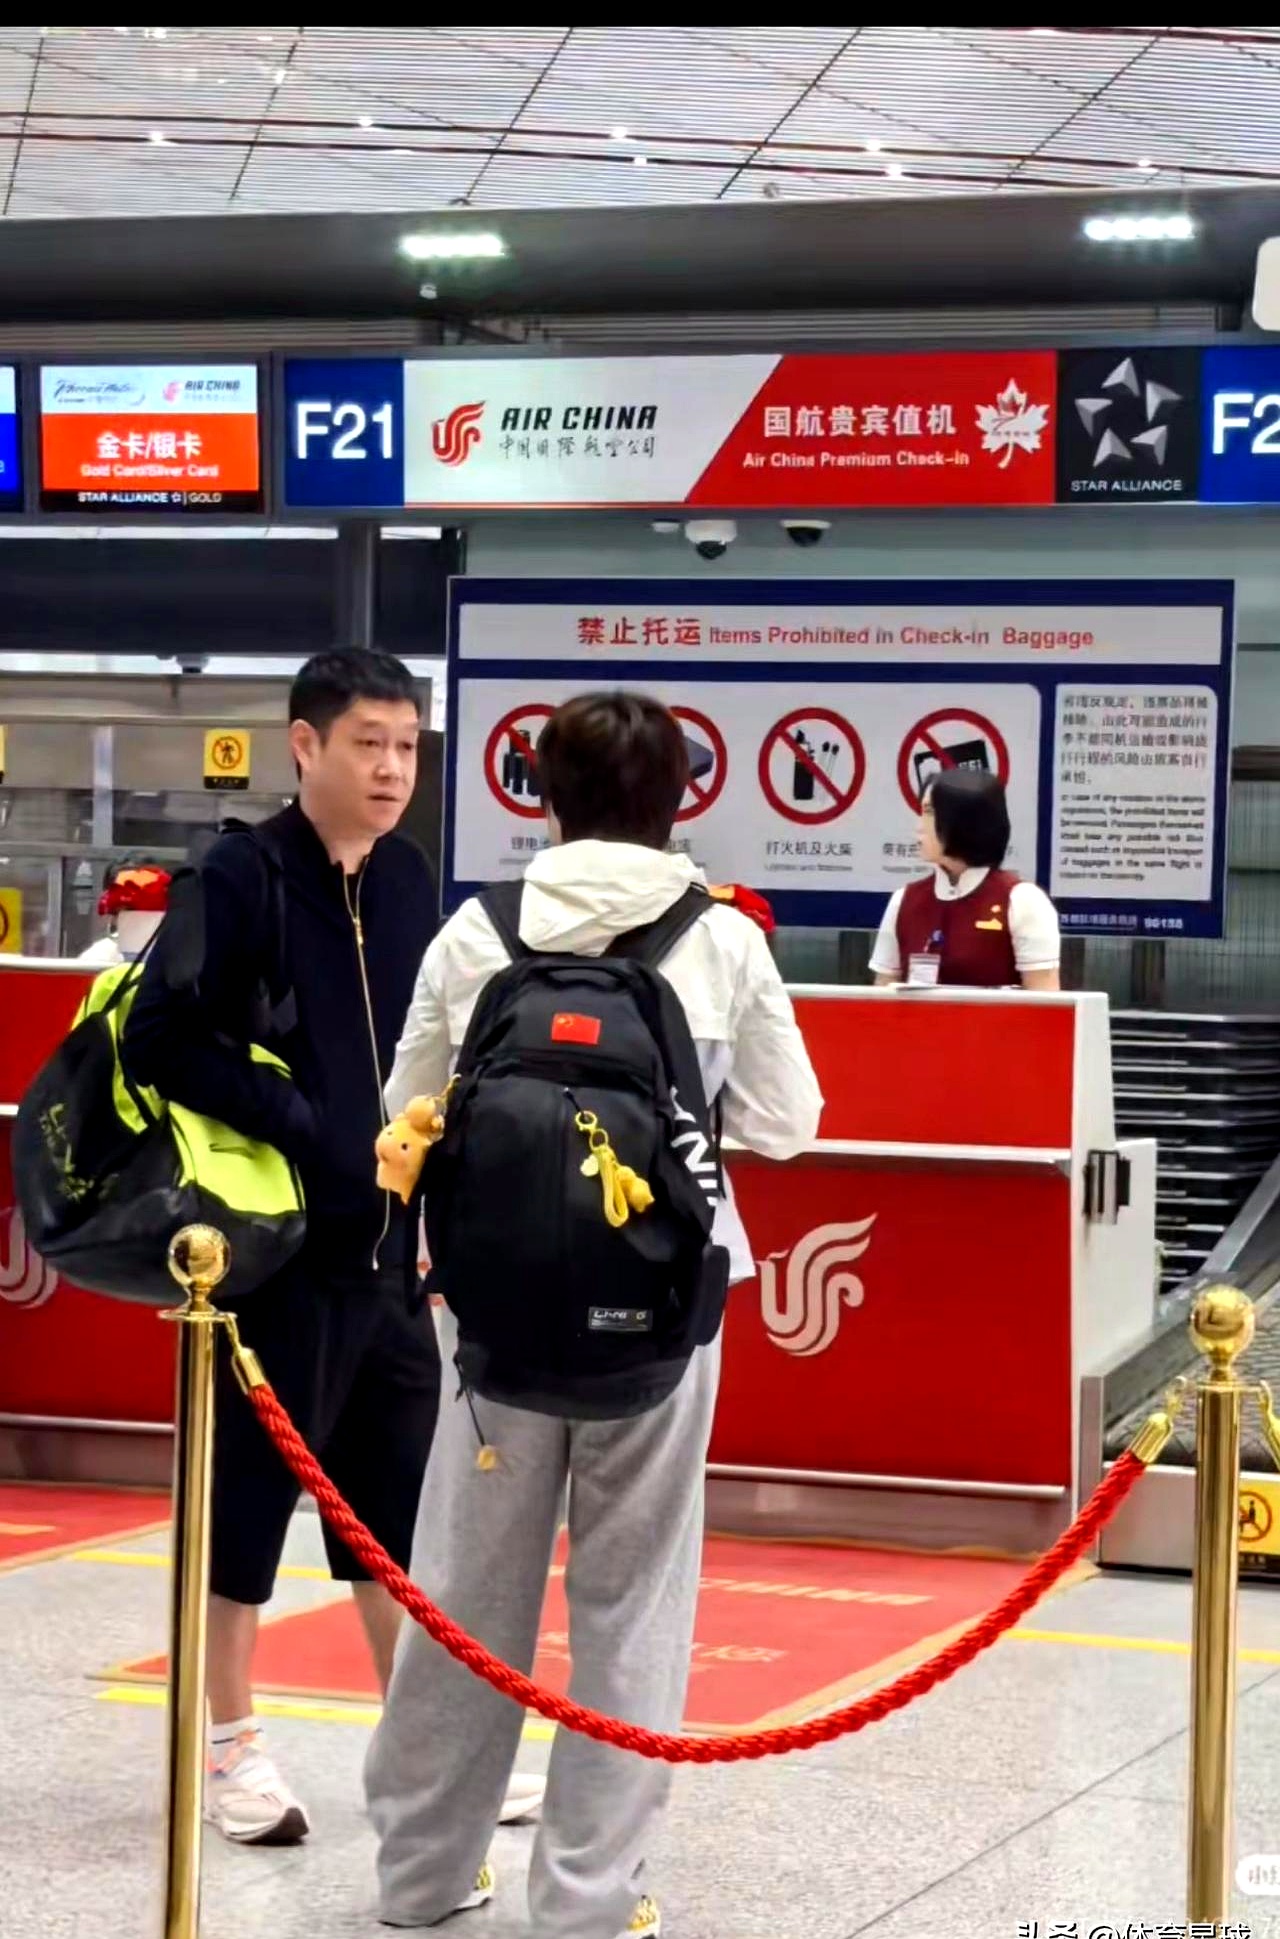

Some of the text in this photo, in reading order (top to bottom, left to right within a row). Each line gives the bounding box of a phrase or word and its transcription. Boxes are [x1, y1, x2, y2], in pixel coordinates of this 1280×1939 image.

[296, 402, 393, 460] F21
[501, 405, 658, 431] AIR CHINA
[763, 404, 957, 438] 国航贵宾值机
[1212, 392, 1280, 455] F2
[96, 431, 203, 460] 金卡/银卡
[743, 450, 970, 468] Air China Premium Check-in
[77, 491, 222, 503] STAR ALLIANCE GOLD
[1070, 479, 1183, 492] STAR ALLIANCE
[577, 616, 1094, 649] 禁止托运 Items Prohibited in Check-in Baggage
